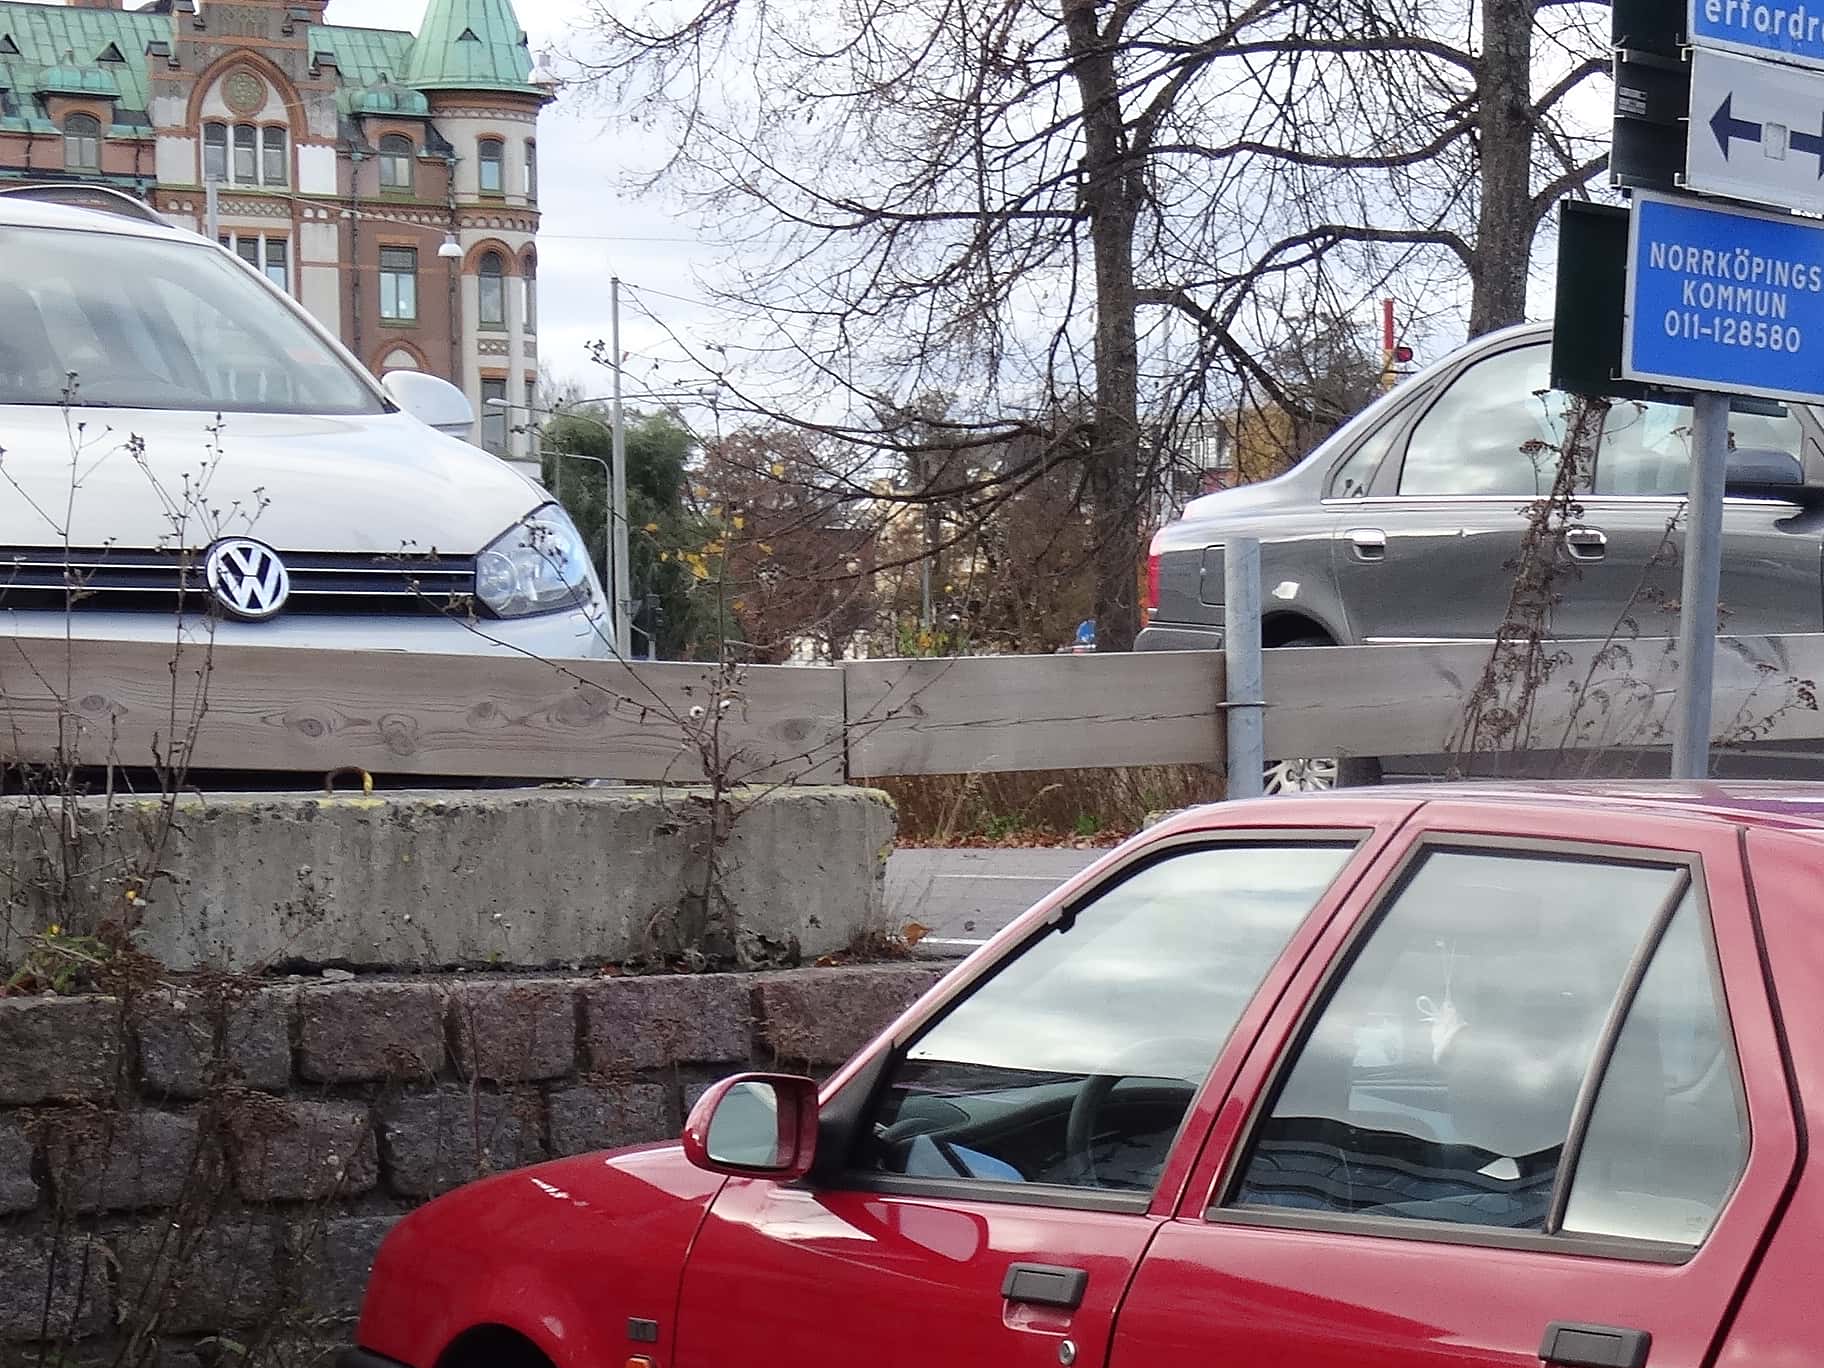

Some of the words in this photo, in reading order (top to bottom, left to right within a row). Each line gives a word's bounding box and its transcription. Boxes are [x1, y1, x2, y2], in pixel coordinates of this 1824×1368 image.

[1649, 241, 1823, 293] NORRKÖPINGS
[1682, 279, 1787, 321] KOMMUN
[1664, 310, 1801, 354] 011-128580
